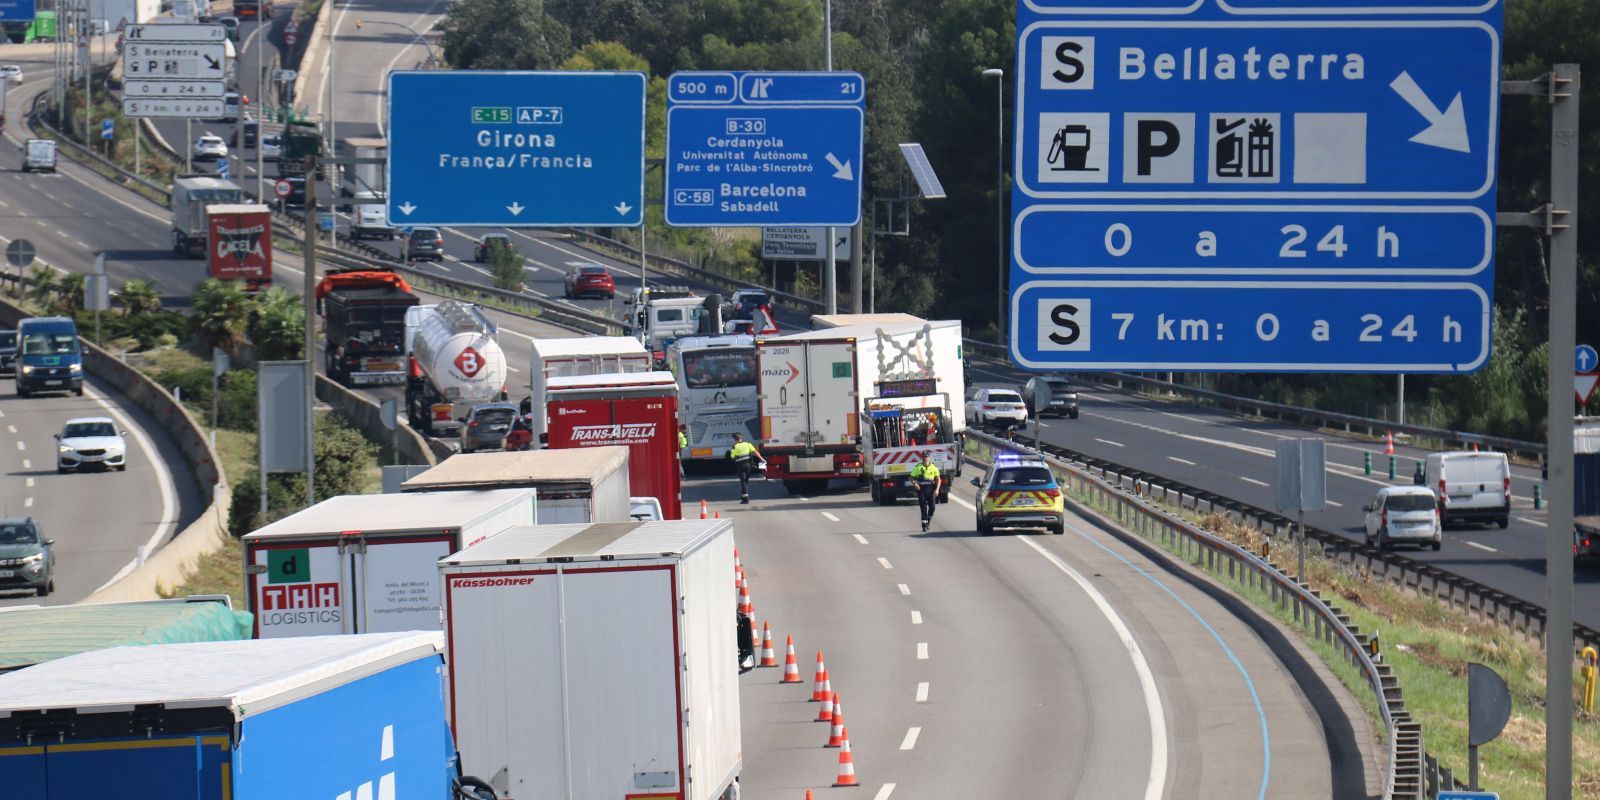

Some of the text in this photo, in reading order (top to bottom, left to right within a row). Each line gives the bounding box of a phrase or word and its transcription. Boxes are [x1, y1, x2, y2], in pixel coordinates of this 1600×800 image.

[131, 47, 198, 56] S Bellaterra
[148, 60, 158, 73] P
[1052, 41, 1365, 83] S Bellaterra
[142, 85, 149, 93] 0
[678, 83, 727, 94] 500 m
[841, 83, 856, 94] 21
[131, 103, 138, 113] S
[474, 110, 559, 121] E-15 AP-7
[729, 121, 763, 132] B-30
[477, 130, 556, 148] Girona
[707, 136, 784, 149] Cerdanyola
[1138, 120, 1180, 176] P
[439, 154, 593, 169] França/Francia
[683, 151, 808, 160] Universitat Autònoma
[677, 163, 700, 172] Parc
[707, 163, 720, 172] de
[677, 183, 806, 203] C-58 Barcelona
[721, 201, 779, 212] Sabadell
[1104, 222, 1400, 258] 0 a 24 h
[1048, 304, 1462, 346] S 7 km: 0 a 24 h
[462, 353, 477, 372] B
[571, 423, 657, 440] TRANS-AVELLA
[282, 556, 296, 575] d
[453, 578, 534, 588] Kässbohrer
[262, 582, 340, 610] THH
[263, 610, 341, 626] LOGISTICS
